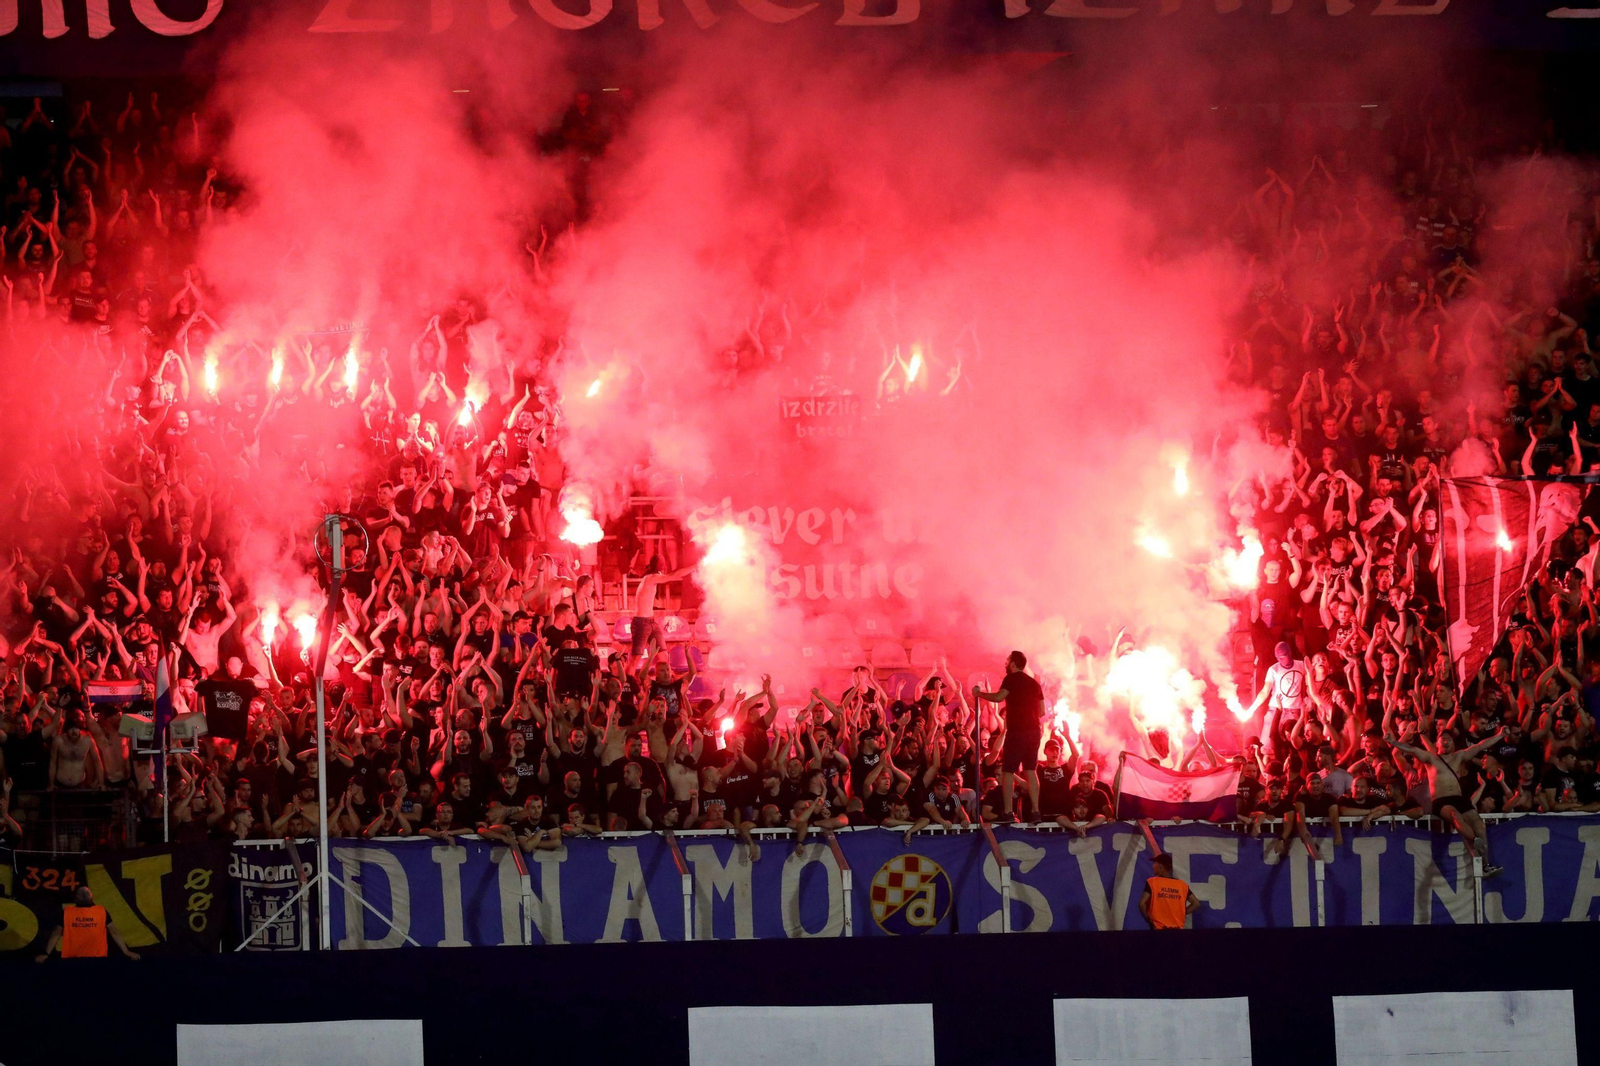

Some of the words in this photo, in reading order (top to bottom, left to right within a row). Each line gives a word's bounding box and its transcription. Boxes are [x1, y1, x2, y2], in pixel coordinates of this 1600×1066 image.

[22, 866, 80, 892] 324
[228, 852, 313, 882] dinamo
[332, 842, 847, 949] DINAMO
